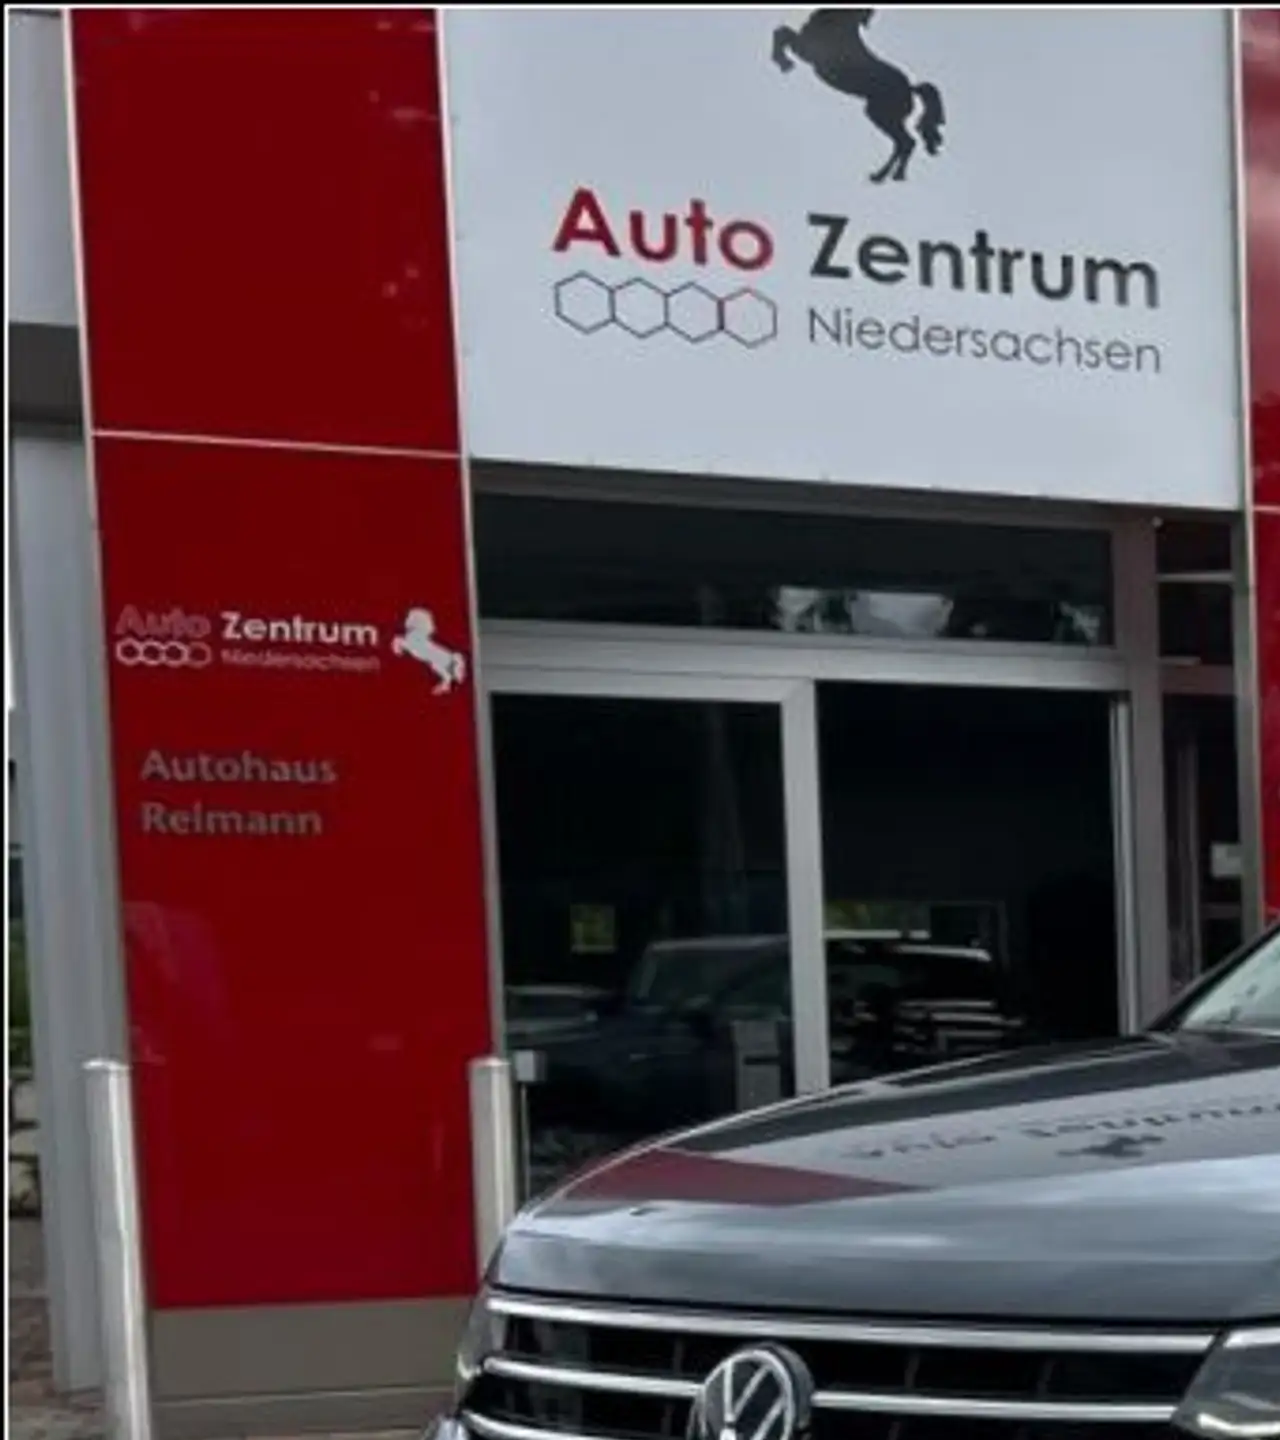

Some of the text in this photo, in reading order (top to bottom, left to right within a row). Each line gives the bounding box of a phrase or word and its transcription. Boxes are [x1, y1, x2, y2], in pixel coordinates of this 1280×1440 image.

[553, 186, 1160, 309] Auto Zentrum
[807, 308, 1161, 373] Niedersachsen
[115, 604, 378, 646] Auto Zentrum
[140, 750, 338, 784] Autohaus
[140, 802, 323, 835] Reimann
